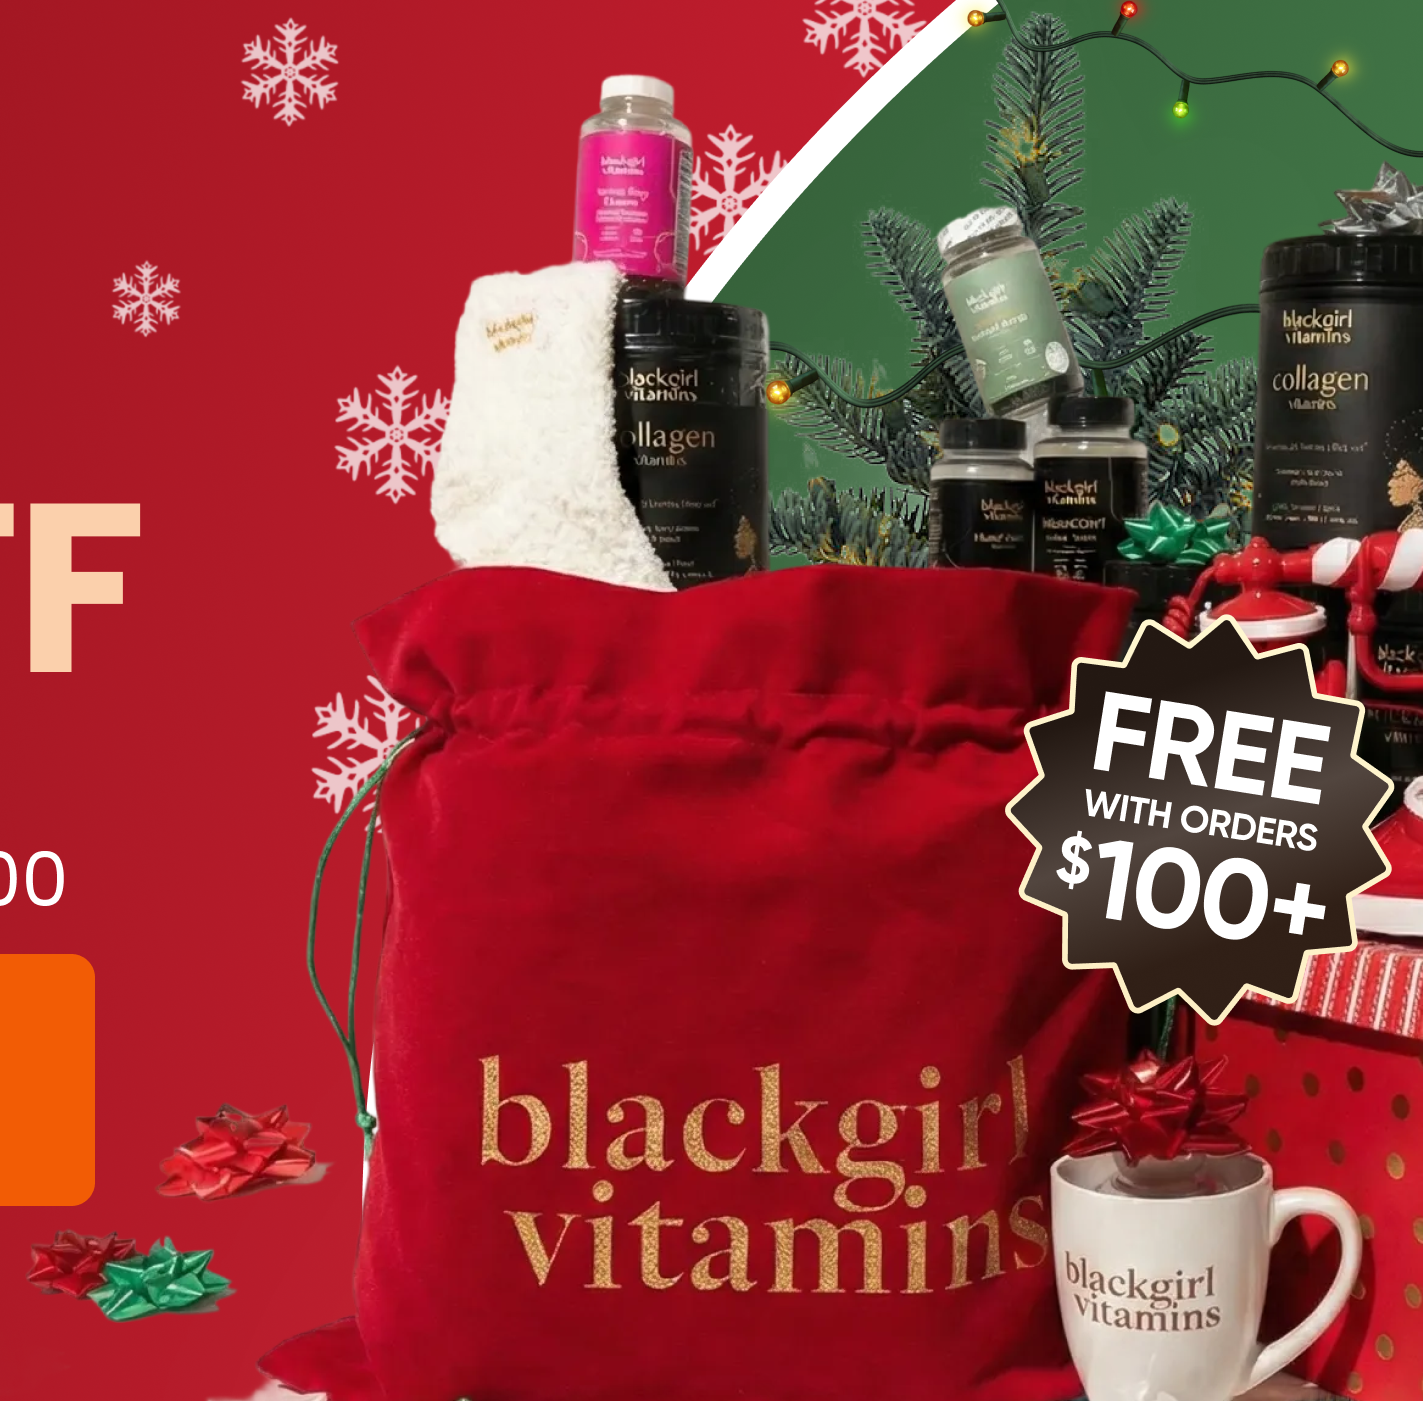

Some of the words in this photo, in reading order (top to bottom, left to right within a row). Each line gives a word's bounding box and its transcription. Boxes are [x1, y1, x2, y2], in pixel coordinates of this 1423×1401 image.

[622, 366, 699, 389] lackgirl
[1272, 364, 1369, 398] collagen
[620, 421, 716, 454] ollagen
[479, 1053, 1029, 1213] blackgirl
[503, 1180, 1049, 1294] vitamins
[1065, 1250, 1215, 1311] blackgirl
[1073, 1292, 1221, 1333] vitamins
